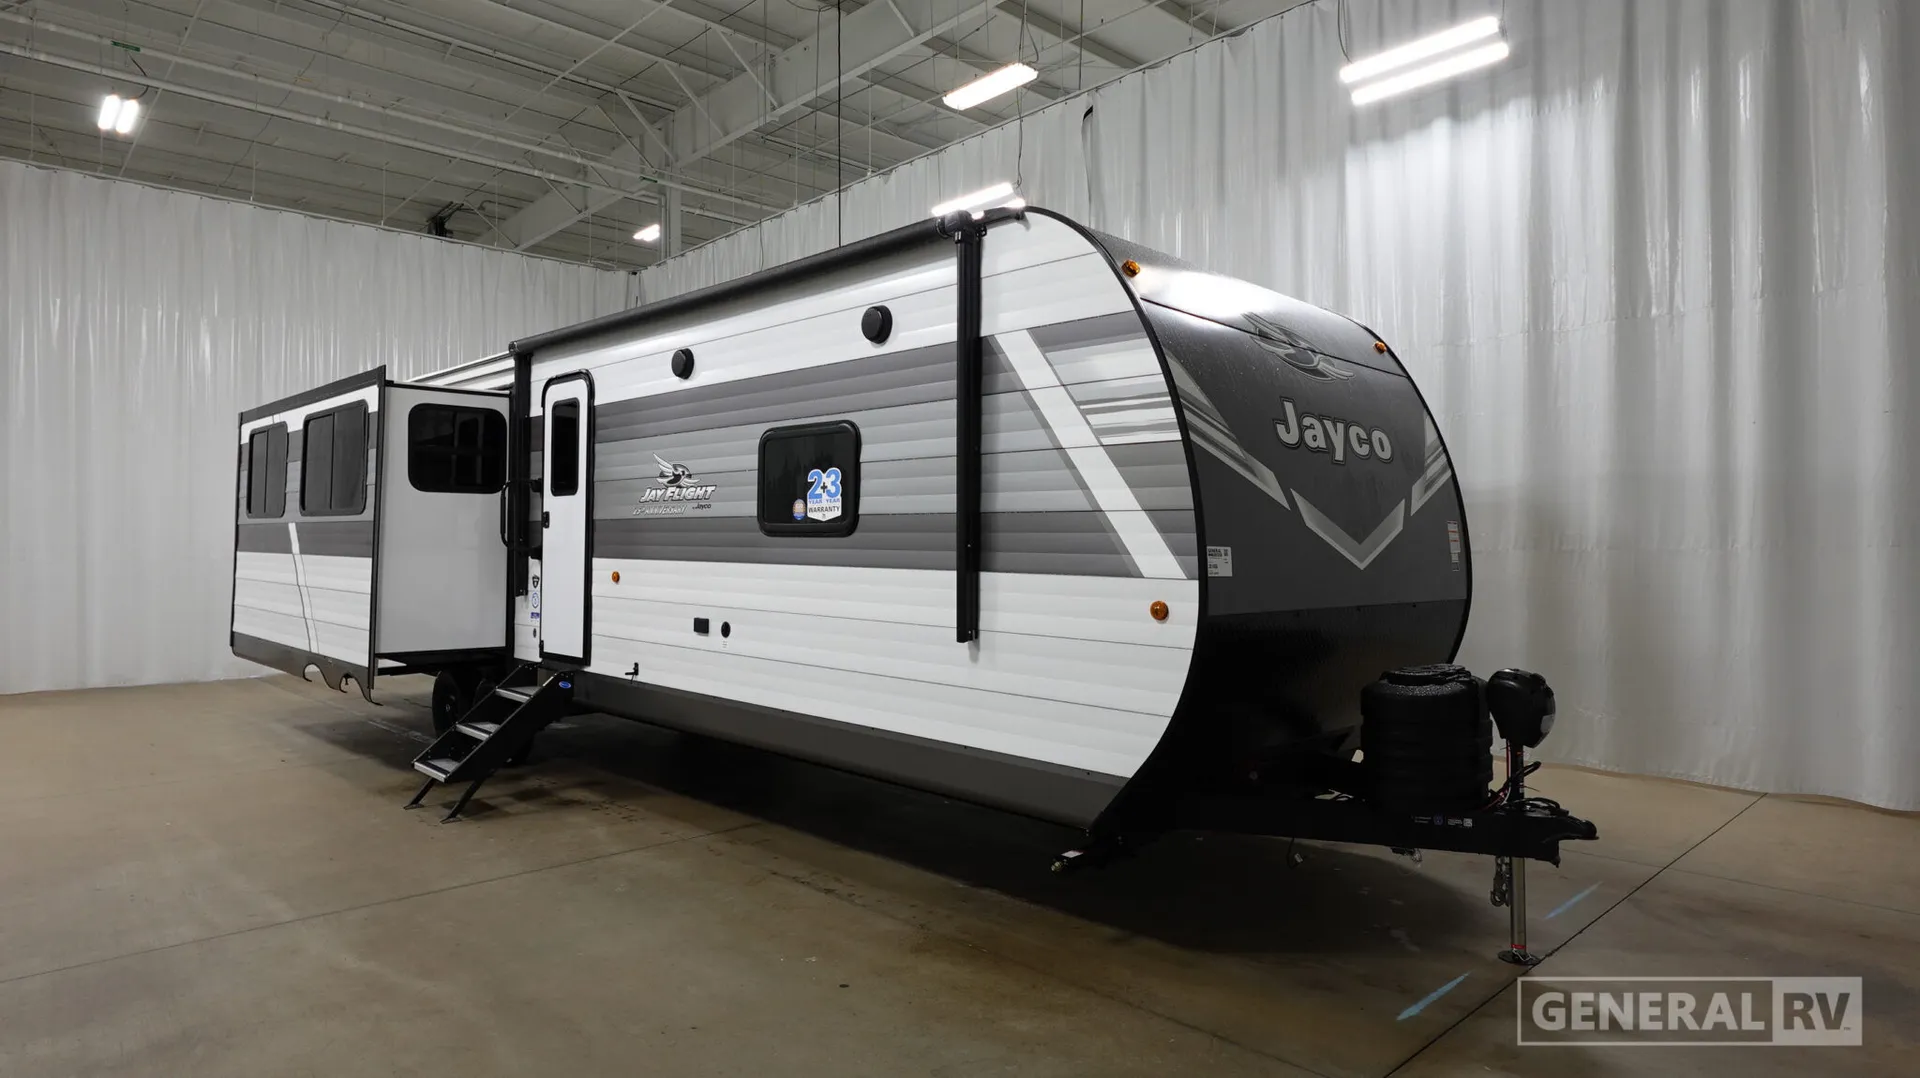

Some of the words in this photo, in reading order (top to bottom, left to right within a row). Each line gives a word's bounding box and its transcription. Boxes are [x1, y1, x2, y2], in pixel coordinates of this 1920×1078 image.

[1272, 396, 1394, 465] Jayco
[639, 487, 666, 503] JAY
[663, 485, 717, 501] FLIGHT
[809, 505, 840, 513] WARRANTY
